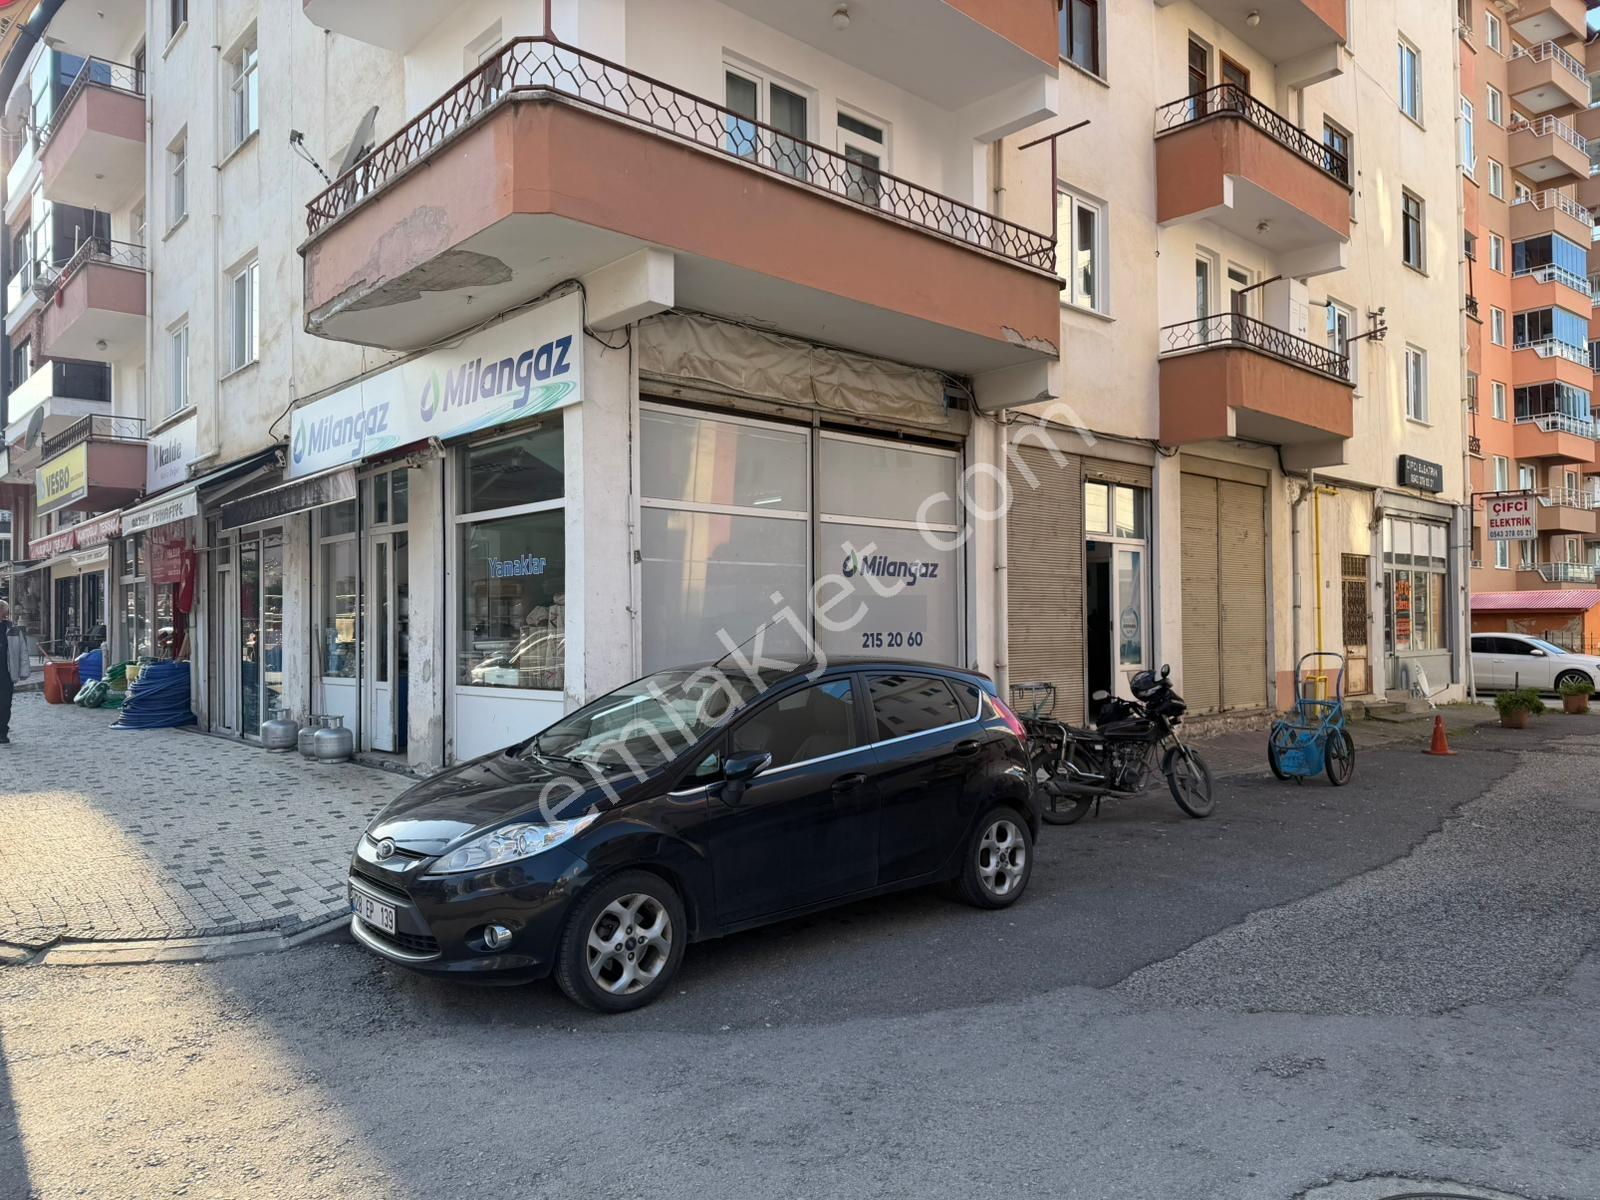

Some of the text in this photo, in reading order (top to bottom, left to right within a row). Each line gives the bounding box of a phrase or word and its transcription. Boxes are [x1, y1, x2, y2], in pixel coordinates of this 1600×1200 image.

[442, 335, 573, 410] Milangaz
[307, 402, 391, 457] Milangaz
[46, 465, 70, 497] VESBO
[1492, 498, 1528, 516] ÇİFCİ
[1490, 514, 1531, 528] ELEKTRİK
[488, 553, 546, 578] Yamaklar
[860, 555, 939, 586] Milangaz
[862, 631, 923, 648] 215 20 60
[381, 906, 394, 930] 139
